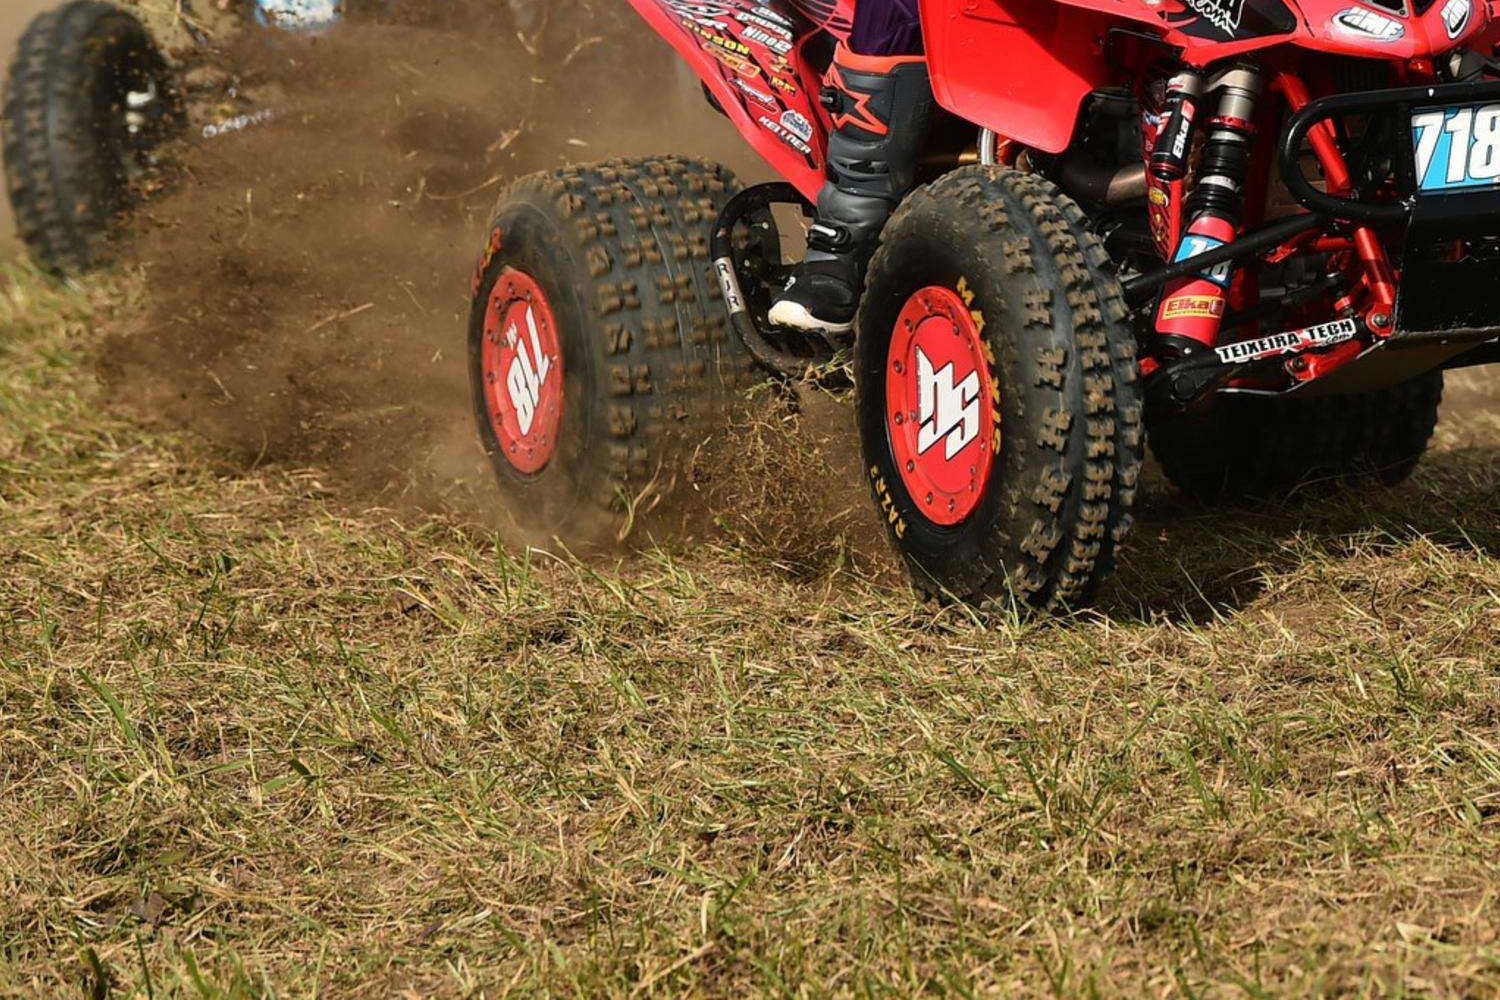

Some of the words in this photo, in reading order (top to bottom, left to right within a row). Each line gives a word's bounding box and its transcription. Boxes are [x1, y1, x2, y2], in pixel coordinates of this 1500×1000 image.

[758, 115, 812, 154] KELLNER
[1172, 118, 1191, 159] Elka
[1167, 299, 1210, 313] Elka
[1218, 334, 1300, 362] TEIXEIRA
[1307, 320, 1354, 341] TECH
[955, 275, 1002, 456] MAXXIS
